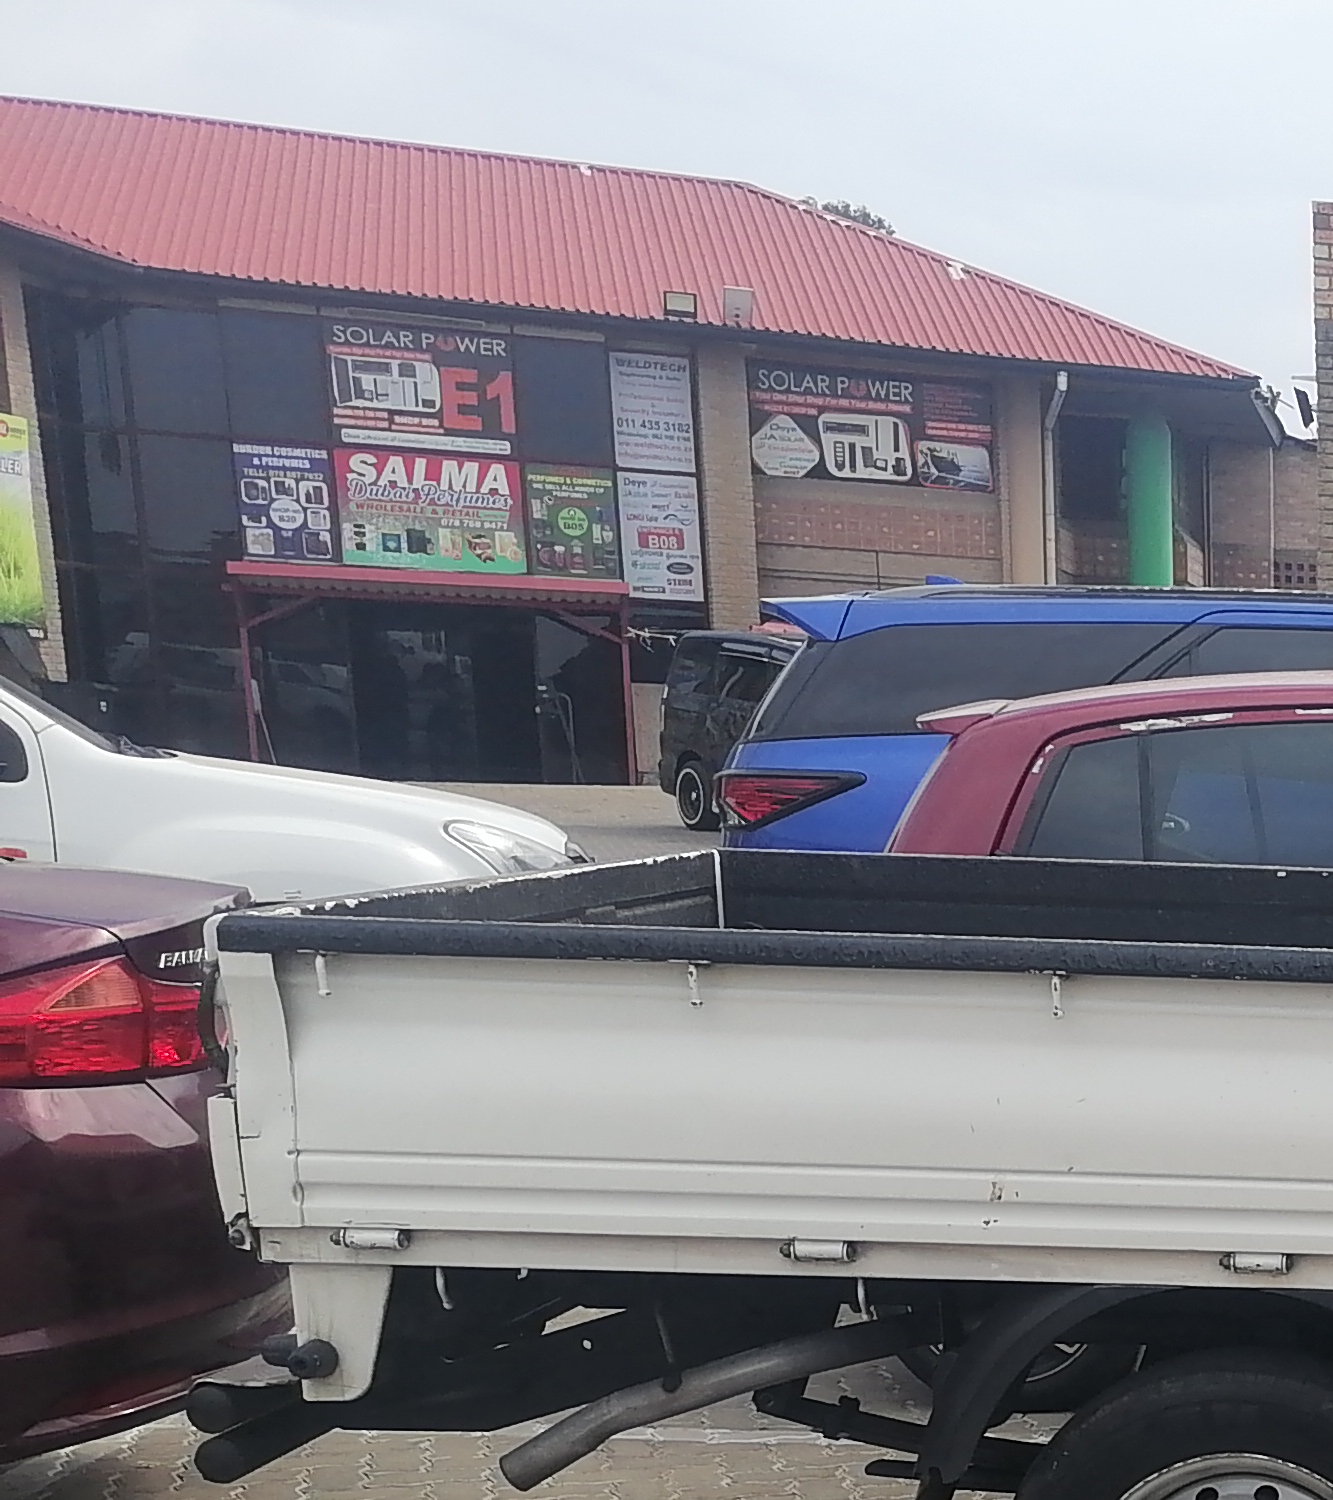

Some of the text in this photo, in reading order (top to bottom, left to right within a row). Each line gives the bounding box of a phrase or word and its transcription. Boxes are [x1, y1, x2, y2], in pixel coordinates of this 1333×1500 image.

[332, 325, 414, 349] SOLAR
[421, 333, 507, 357] POWER
[614, 357, 687, 373] WELDTECH
[758, 369, 830, 395] SOLAR
[837, 376, 913, 402] POWER
[440, 367, 516, 434] E1
[616, 417, 636, 428] 011
[640, 420, 660, 431] 435
[348, 453, 510, 495] SALMA
[623, 477, 648, 488] Deye
[349, 478, 512, 509] Dubai Perfumes
[355, 502, 426, 515] WHOLESALE
[442, 509, 482, 519] RETAIL
[648, 535, 678, 549] B08
